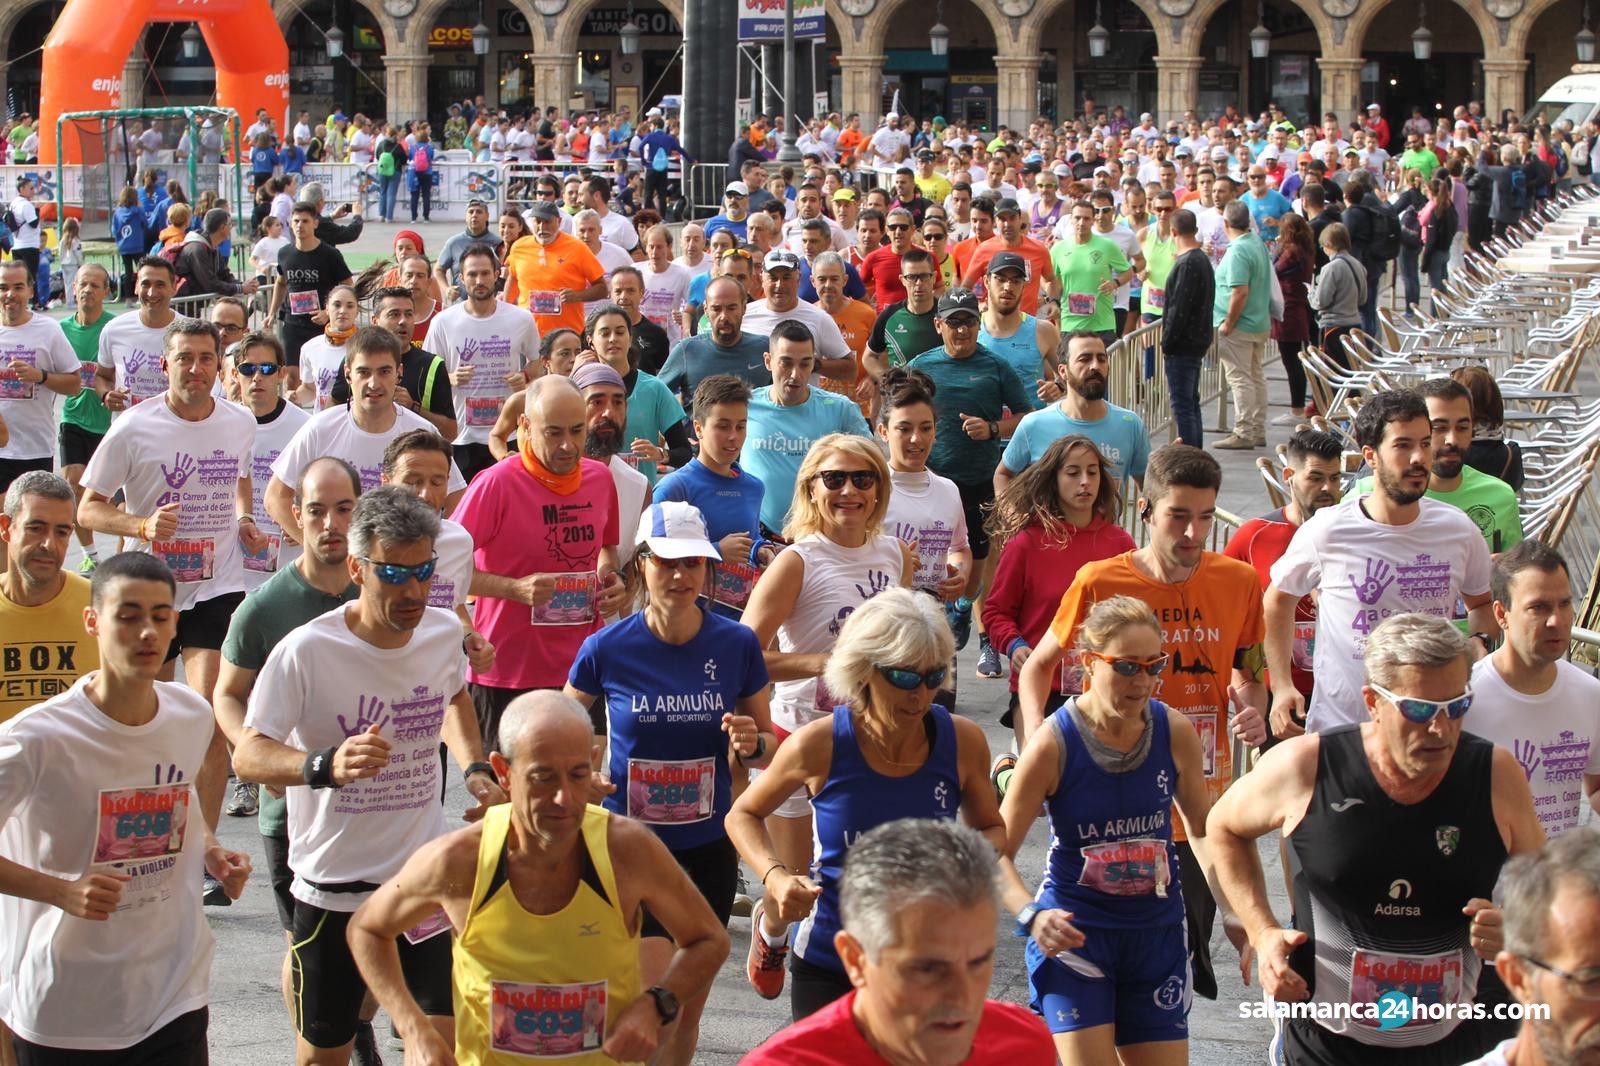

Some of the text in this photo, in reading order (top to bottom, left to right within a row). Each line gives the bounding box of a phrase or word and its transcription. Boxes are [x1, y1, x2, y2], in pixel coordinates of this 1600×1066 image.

[92, 75, 121, 96] enjo
[287, 269, 319, 280] BOSS
[563, 524, 595, 543] 2013
[3, 646, 76, 672] BOX
[1185, 684, 1210, 695] 2017
[632, 690, 724, 712] LA ARMUÑA
[667, 714, 712, 722] DEPORTIVO
[116, 811, 171, 839] 608
[1077, 823, 1099, 839] LA
[1104, 809, 1165, 837] ARMUÑA
[1374, 903, 1421, 916] Adarsa
[515, 1010, 583, 1034] 603
